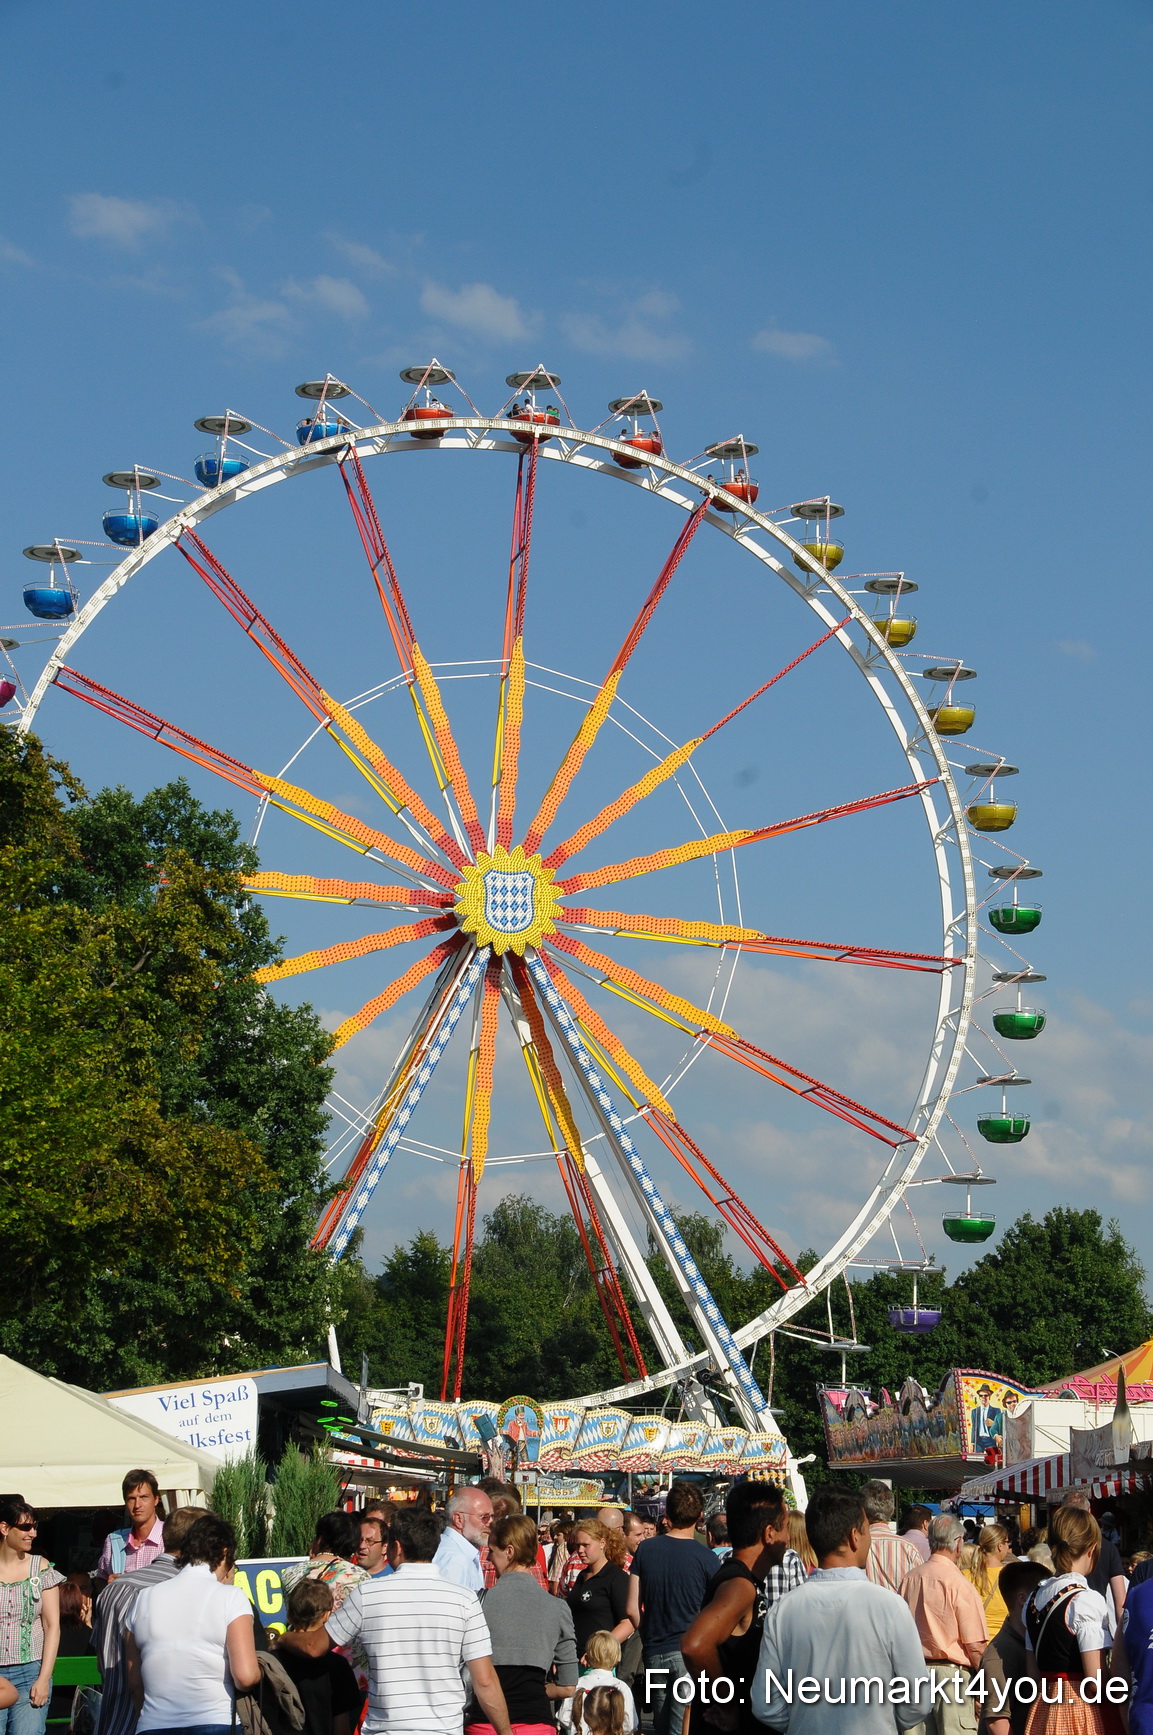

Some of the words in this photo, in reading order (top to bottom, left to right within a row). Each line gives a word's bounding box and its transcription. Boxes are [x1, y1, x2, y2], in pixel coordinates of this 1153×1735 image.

[158, 1393, 195, 1412] Viel
[202, 1385, 249, 1409] Spaß
[179, 1415, 199, 1428] auf
[205, 1412, 232, 1424] dem
[176, 1429, 251, 1448] lksfest
